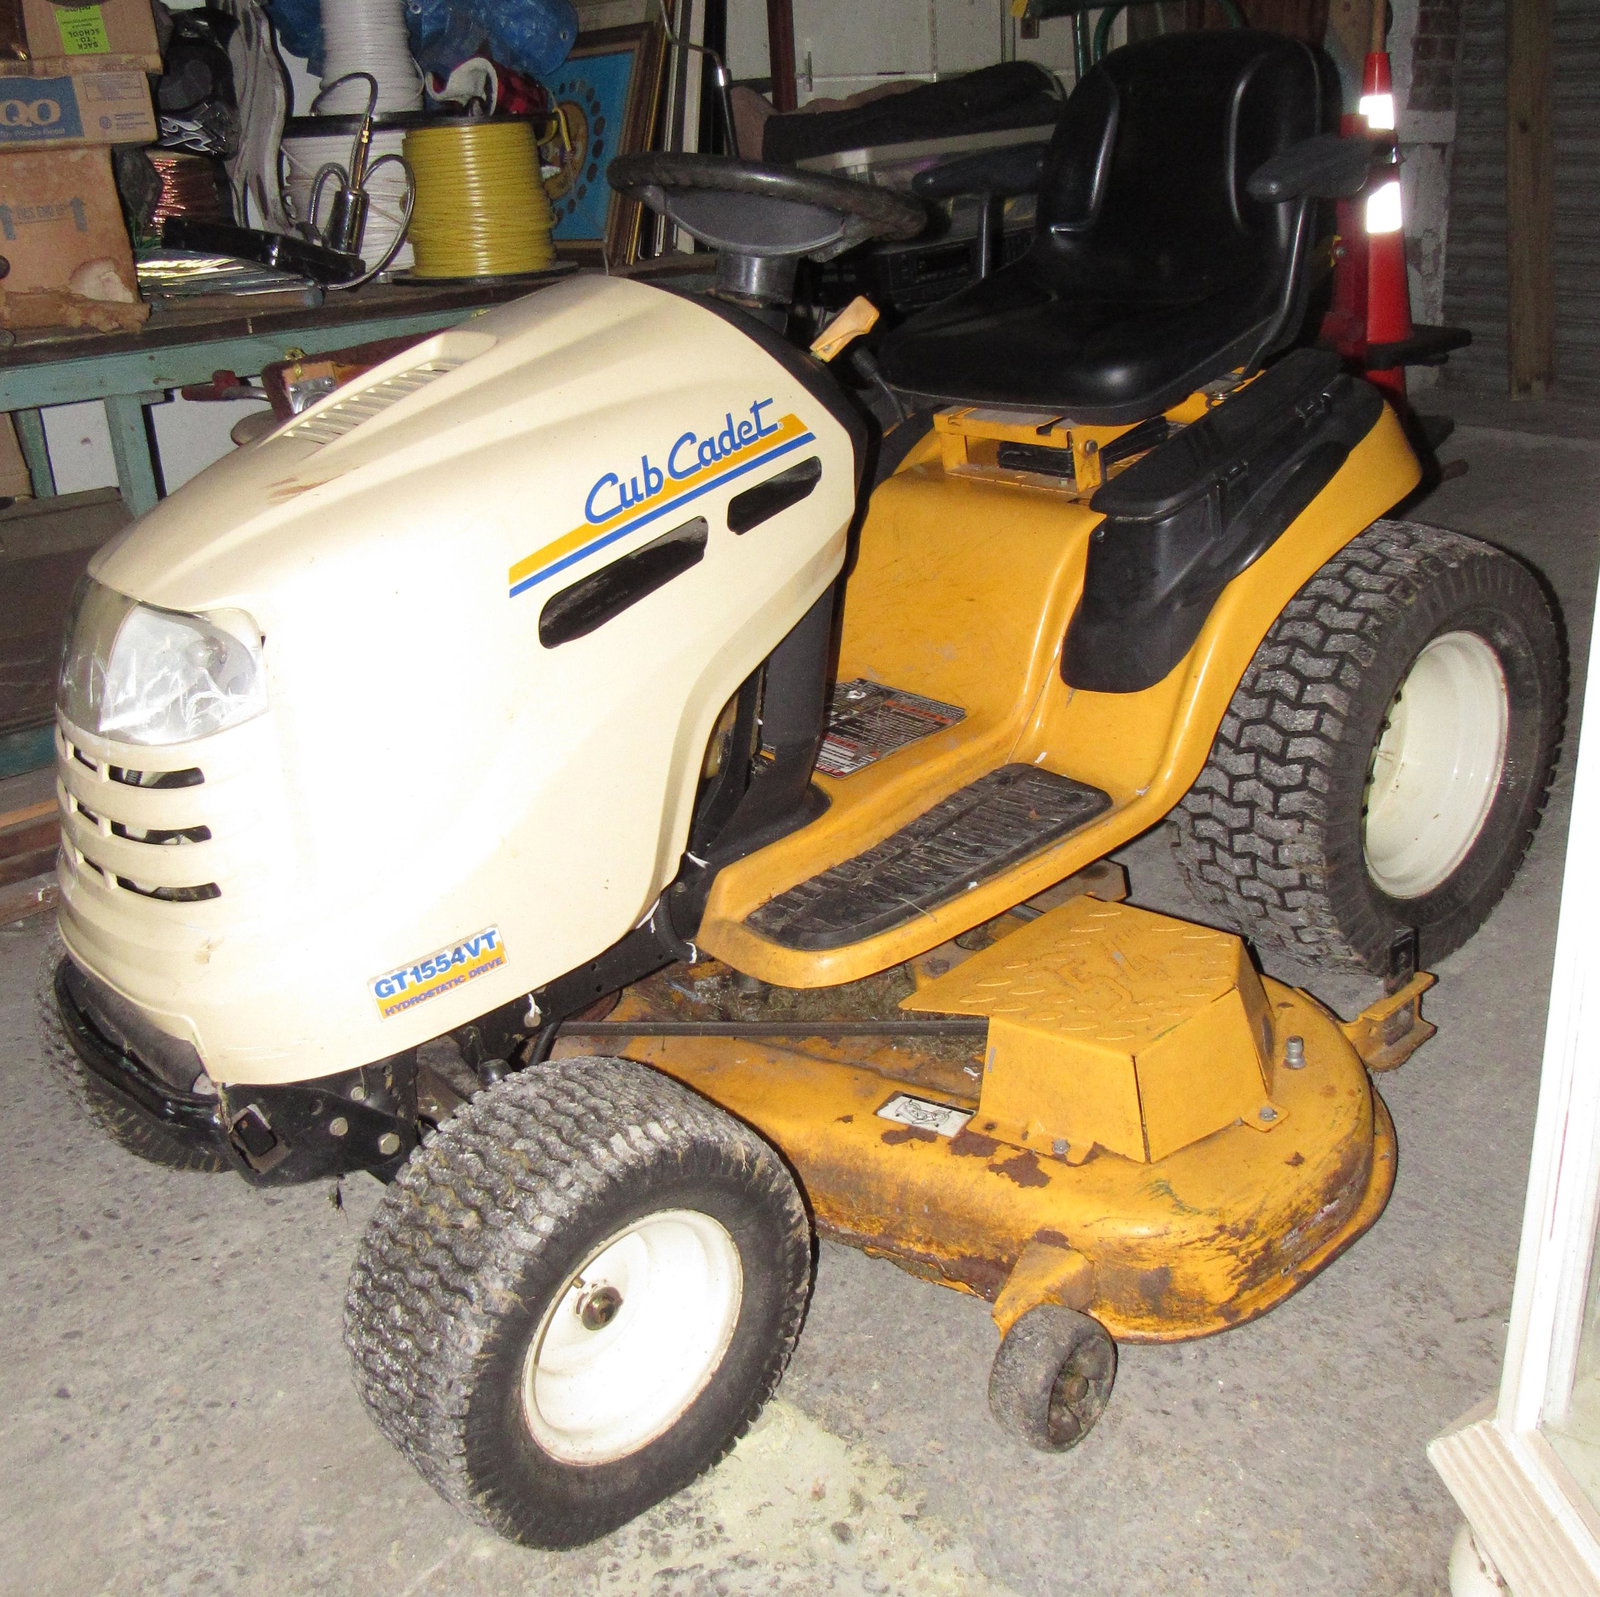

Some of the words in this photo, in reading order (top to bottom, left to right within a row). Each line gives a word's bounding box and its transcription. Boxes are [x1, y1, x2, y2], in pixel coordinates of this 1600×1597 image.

[68, 28, 100, 38] SCHOOL
[77, 41, 99, 50] BACK
[584, 455, 664, 524] Cub
[667, 397, 778, 480] Cadet
[374, 930, 497, 998] GT1554VT
[384, 974, 467, 1017] HYDROSTATIC
[468, 957, 504, 978] DRIVE
